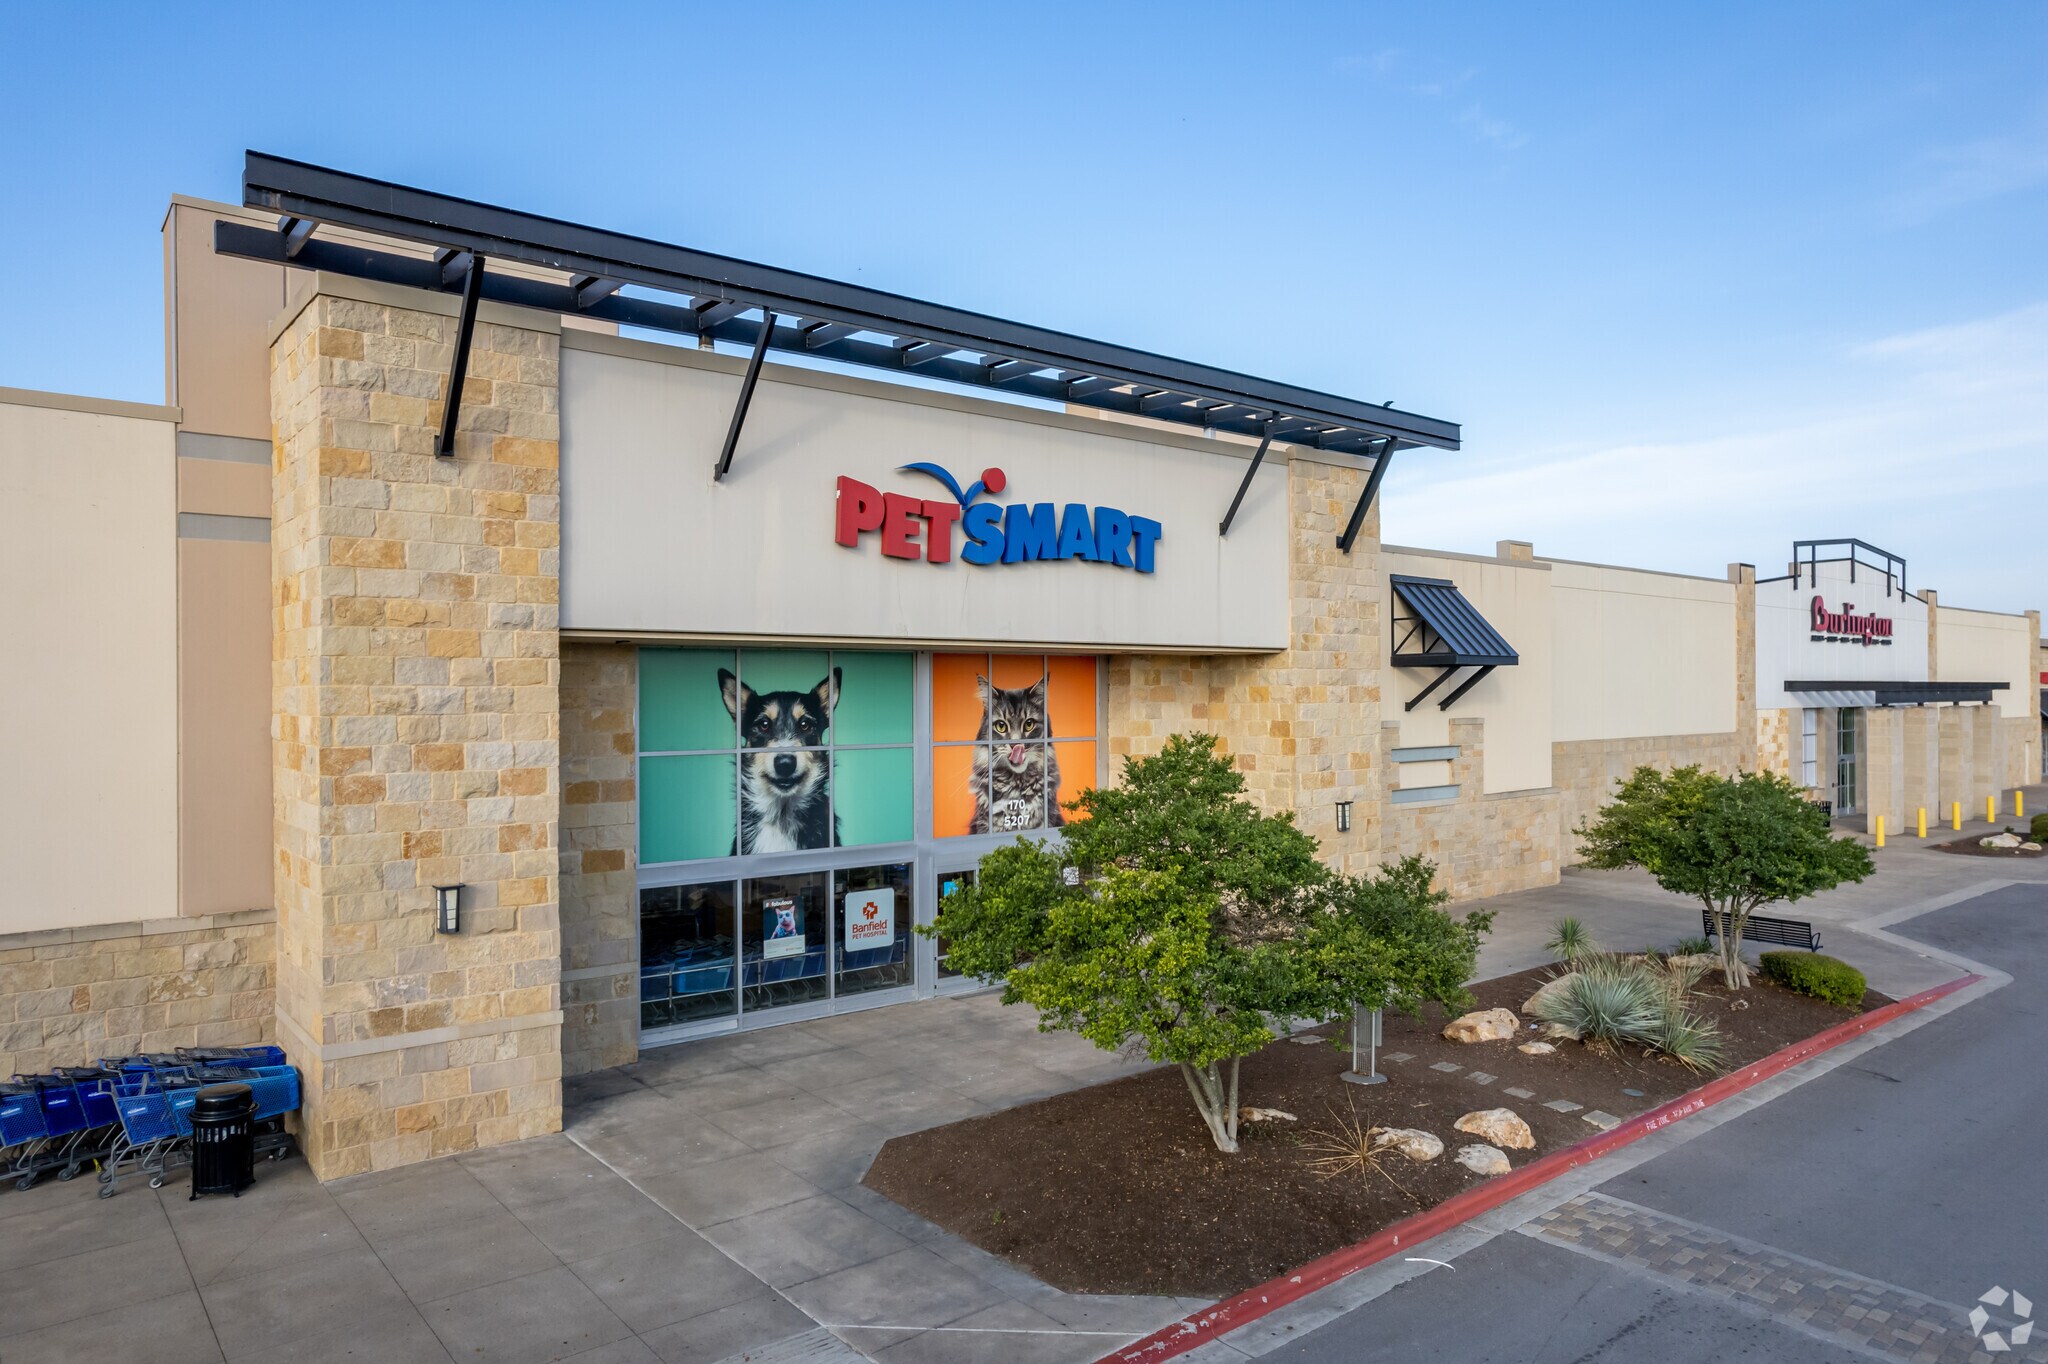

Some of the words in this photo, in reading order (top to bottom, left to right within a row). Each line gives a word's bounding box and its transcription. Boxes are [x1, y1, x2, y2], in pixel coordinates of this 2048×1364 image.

[1811, 595, 1893, 646] Burlington
[1008, 799, 1025, 810] 170
[1004, 815, 1030, 827] 5207
[852, 920, 887, 934] Banfield
[863, 930, 888, 938] HOSPITAL
